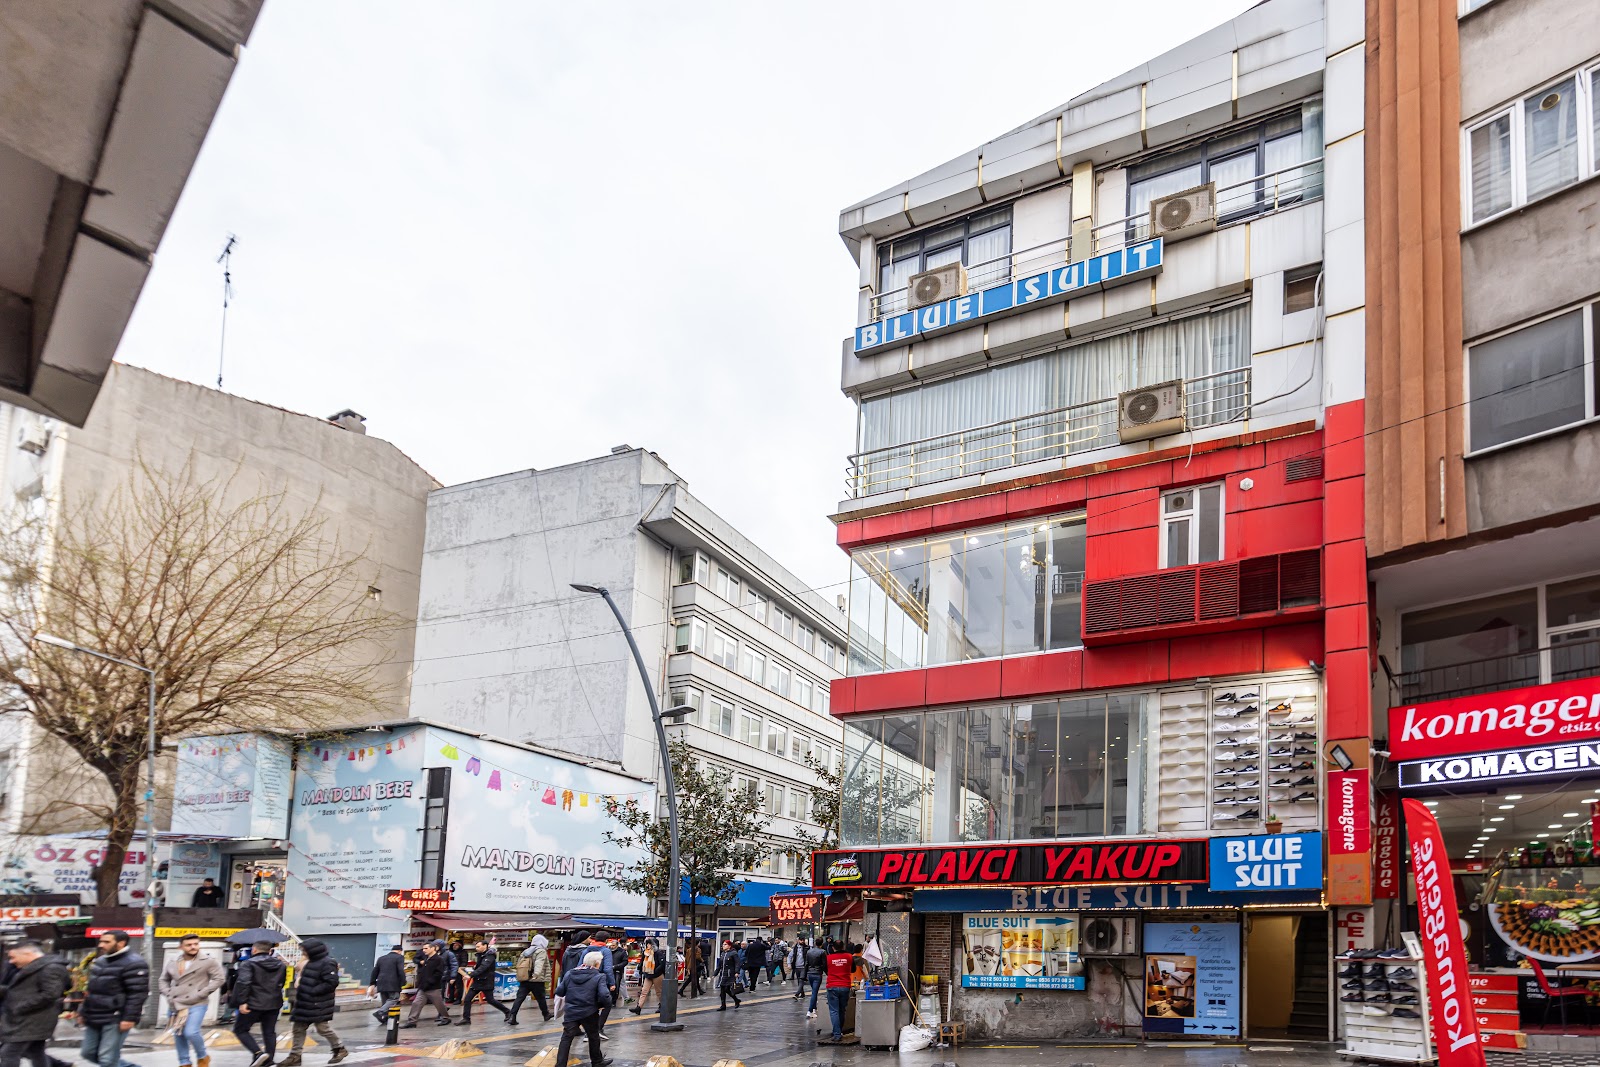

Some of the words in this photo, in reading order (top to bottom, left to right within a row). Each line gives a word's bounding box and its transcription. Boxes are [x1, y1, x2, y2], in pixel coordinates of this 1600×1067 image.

[861, 297, 971, 348] BLUE
[1025, 243, 1153, 301] SUIT
[1559, 721, 1592, 735] etsiz
[375, 781, 412, 800] BEBE
[1338, 778, 1358, 851] komagene
[34, 844, 76, 862] ÖZ
[1225, 837, 1303, 863] BLUE
[1377, 804, 1395, 888] komagene
[581, 858, 624, 880] BEBE
[1044, 845, 1181, 880] YAKUP
[1235, 863, 1302, 888] SUIT
[539, 882, 565, 892] ÇOCUK
[1011, 888, 1092, 909] BLUE
[1114, 885, 1193, 907] SUIT
[400, 900, 448, 908] BURADAN
[772, 897, 818, 909] YAKUP
[777, 909, 813, 921] USTA
[968, 918, 999, 928] BLUE
